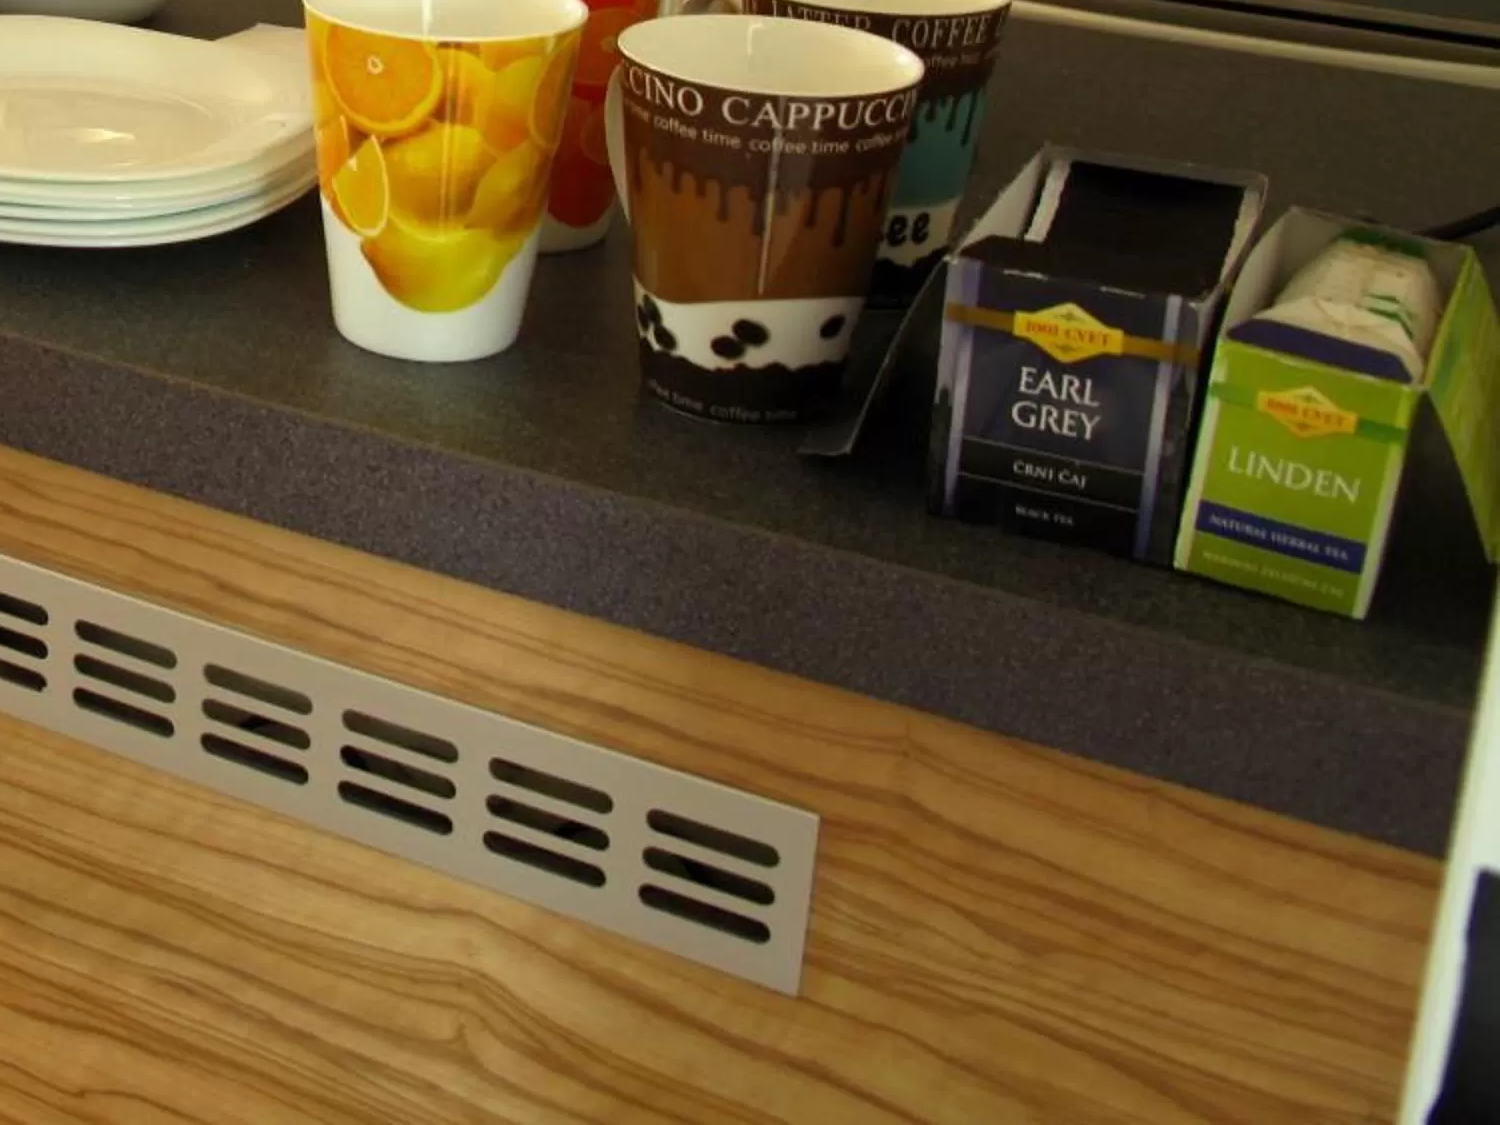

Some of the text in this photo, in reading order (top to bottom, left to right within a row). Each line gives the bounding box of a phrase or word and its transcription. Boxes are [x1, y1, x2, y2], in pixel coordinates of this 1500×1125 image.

[627, 65, 705, 117] CINO
[702, 127, 742, 150] time
[811, 136, 851, 155] time
[1018, 366, 1101, 408] EARL
[1011, 400, 1101, 441] GREY
[1228, 444, 1361, 504] LINDEN
[1323, 543, 1349, 561] TEA
